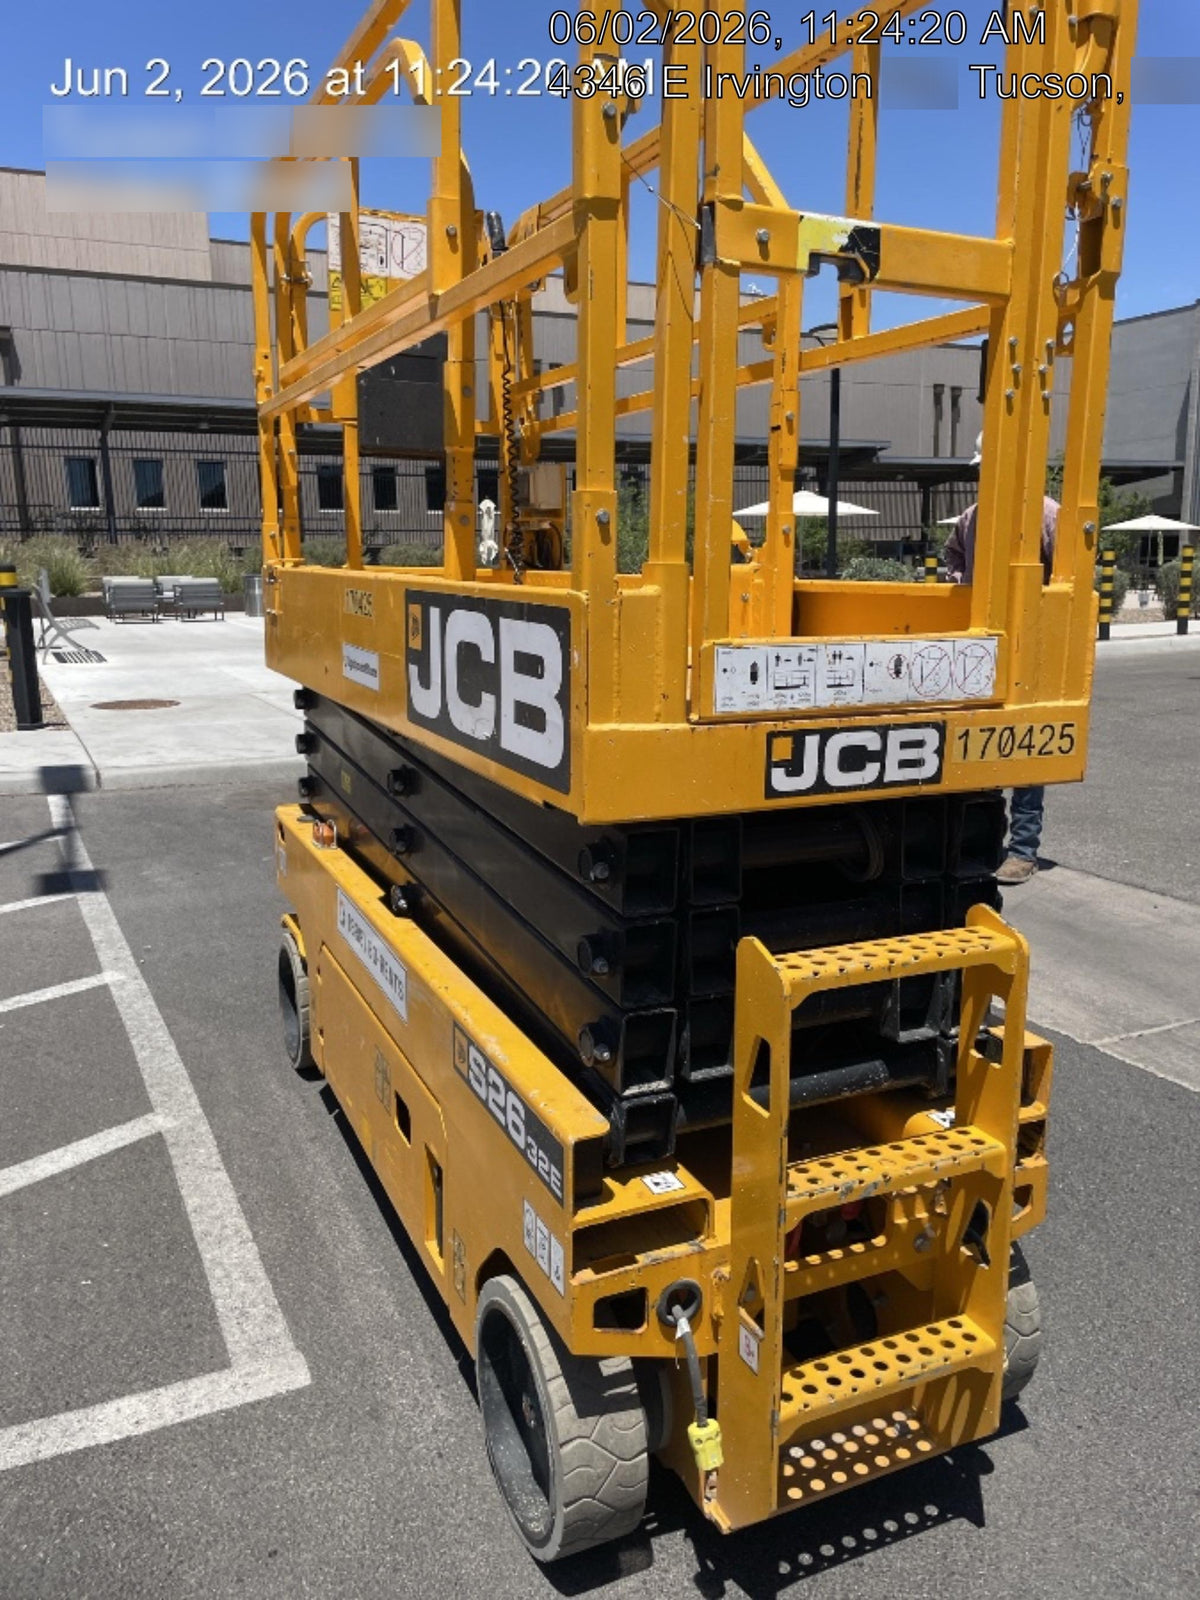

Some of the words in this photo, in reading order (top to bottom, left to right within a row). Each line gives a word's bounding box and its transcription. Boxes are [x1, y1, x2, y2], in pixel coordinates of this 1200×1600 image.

[408, 605, 565, 769] JCB
[770, 727, 940, 792] JCB
[957, 722, 1076, 760] 170425
